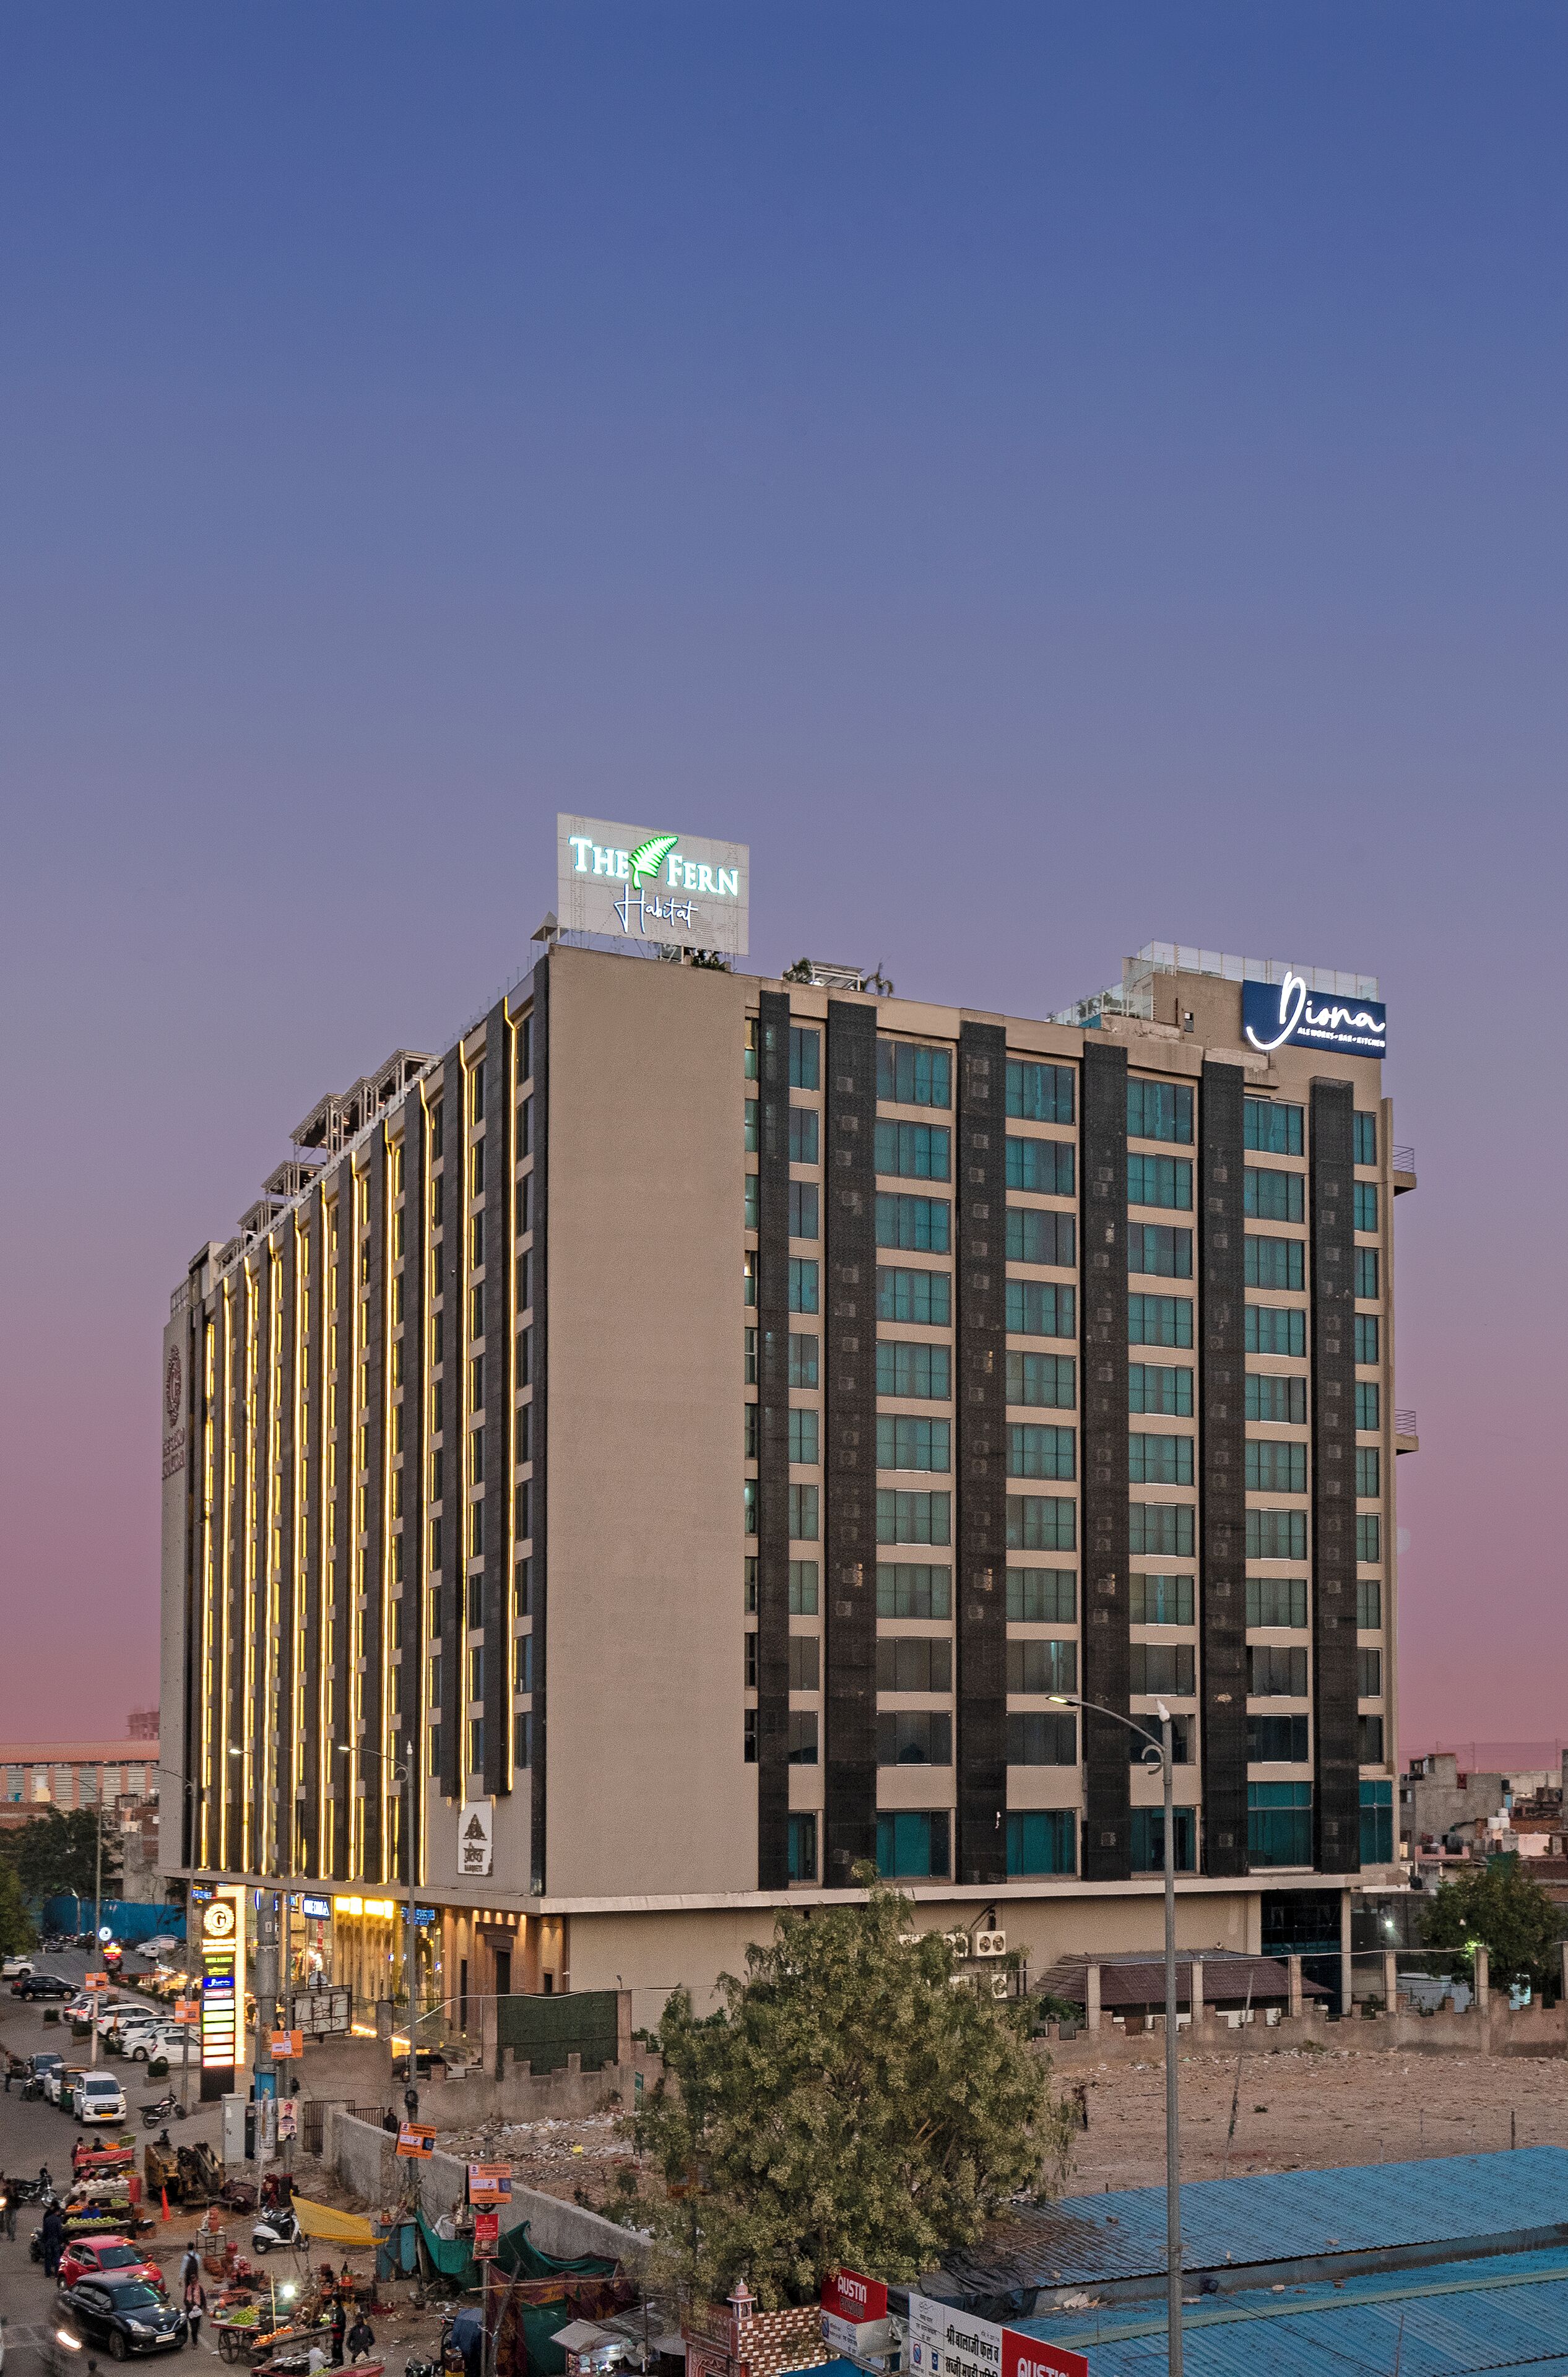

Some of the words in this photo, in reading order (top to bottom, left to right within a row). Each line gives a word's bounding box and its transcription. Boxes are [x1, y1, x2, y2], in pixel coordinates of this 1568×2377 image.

[568, 836, 629, 879] THE
[666, 853, 739, 896] FERN
[613, 883, 699, 933] Habitat
[838, 2275, 867, 2303] AUSTIN
[946, 2324, 955, 2346] श्री
[956, 2331, 979, 2356] बालाजी
[1017, 2357, 1067, 2377] AUS
